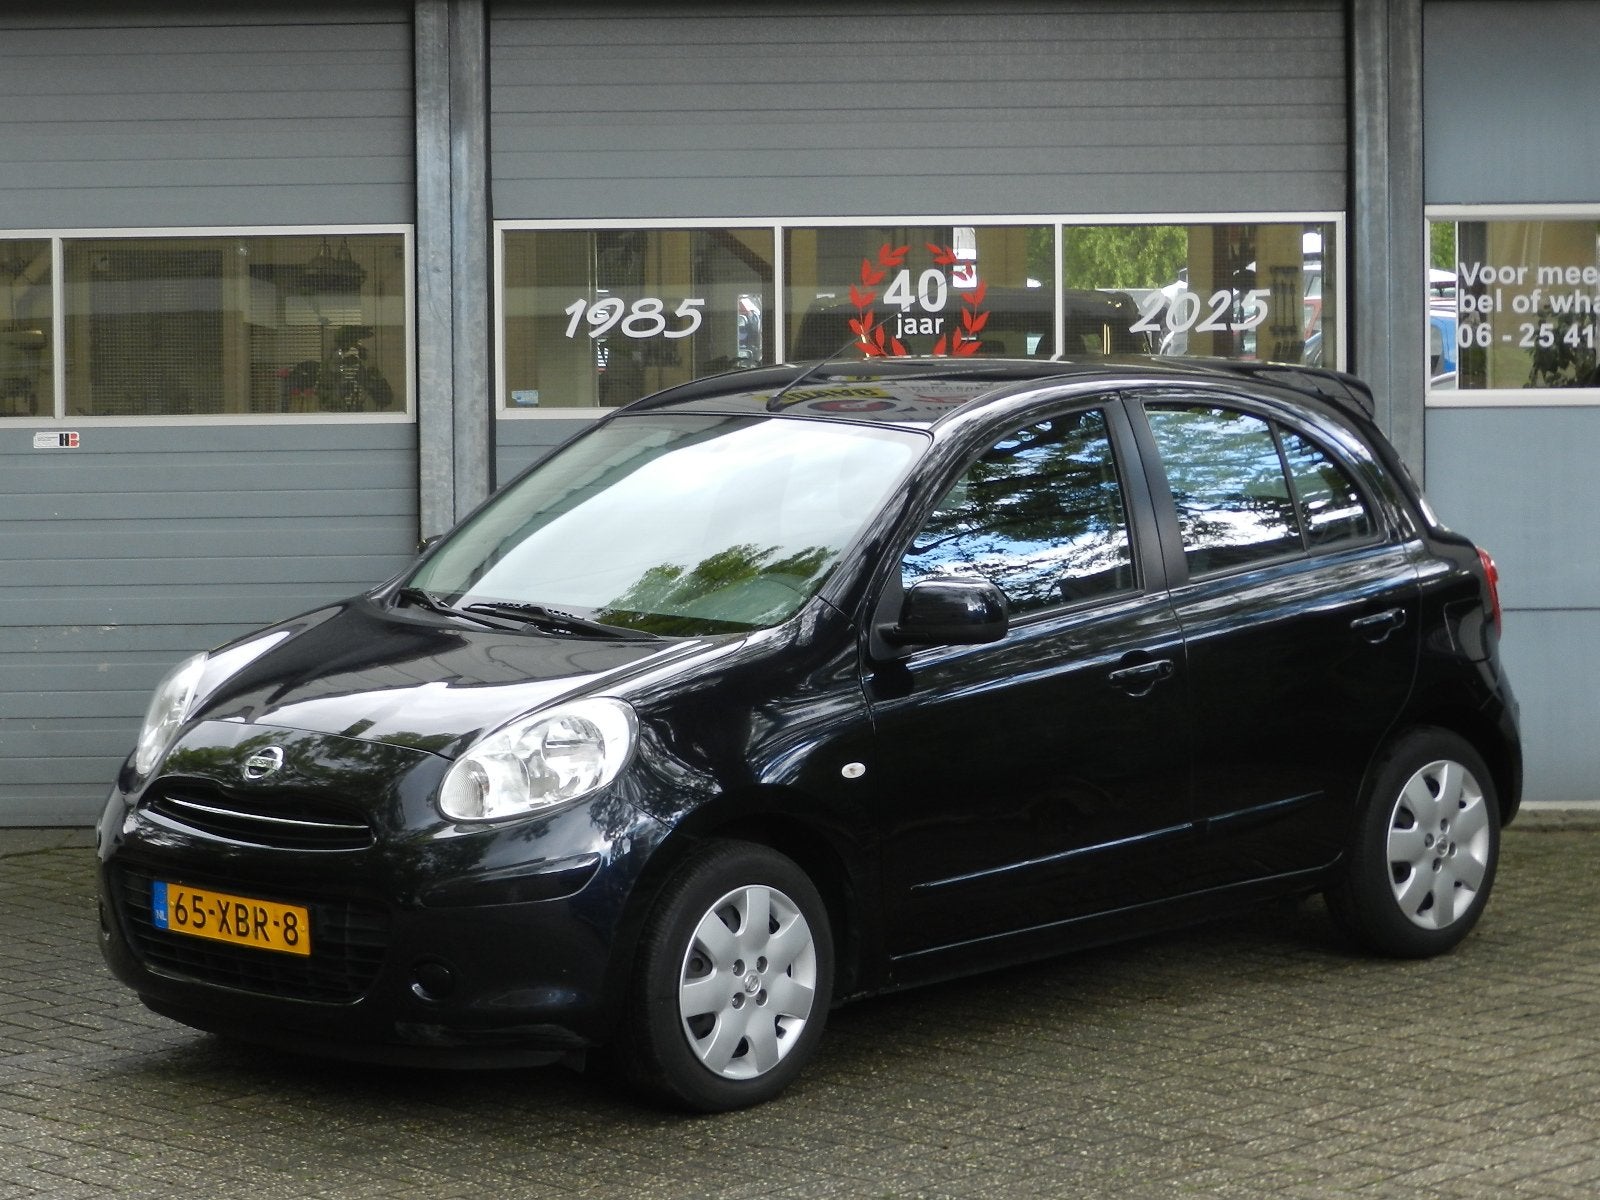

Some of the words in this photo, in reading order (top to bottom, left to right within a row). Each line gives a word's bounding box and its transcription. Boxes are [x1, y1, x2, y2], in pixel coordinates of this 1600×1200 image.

[883, 269, 948, 312] 40
[1459, 261, 1528, 286] Voor
[565, 297, 705, 338] 1985
[1128, 288, 1271, 333] 2025
[1459, 288, 1502, 314] bel
[1512, 288, 1542, 313] of
[895, 313, 945, 339] jaar
[1458, 322, 1492, 348] 06
[1519, 322, 1555, 348] 25
[1563, 322, 1594, 349] 41
[174, 891, 300, 947] 65-XBR-8
